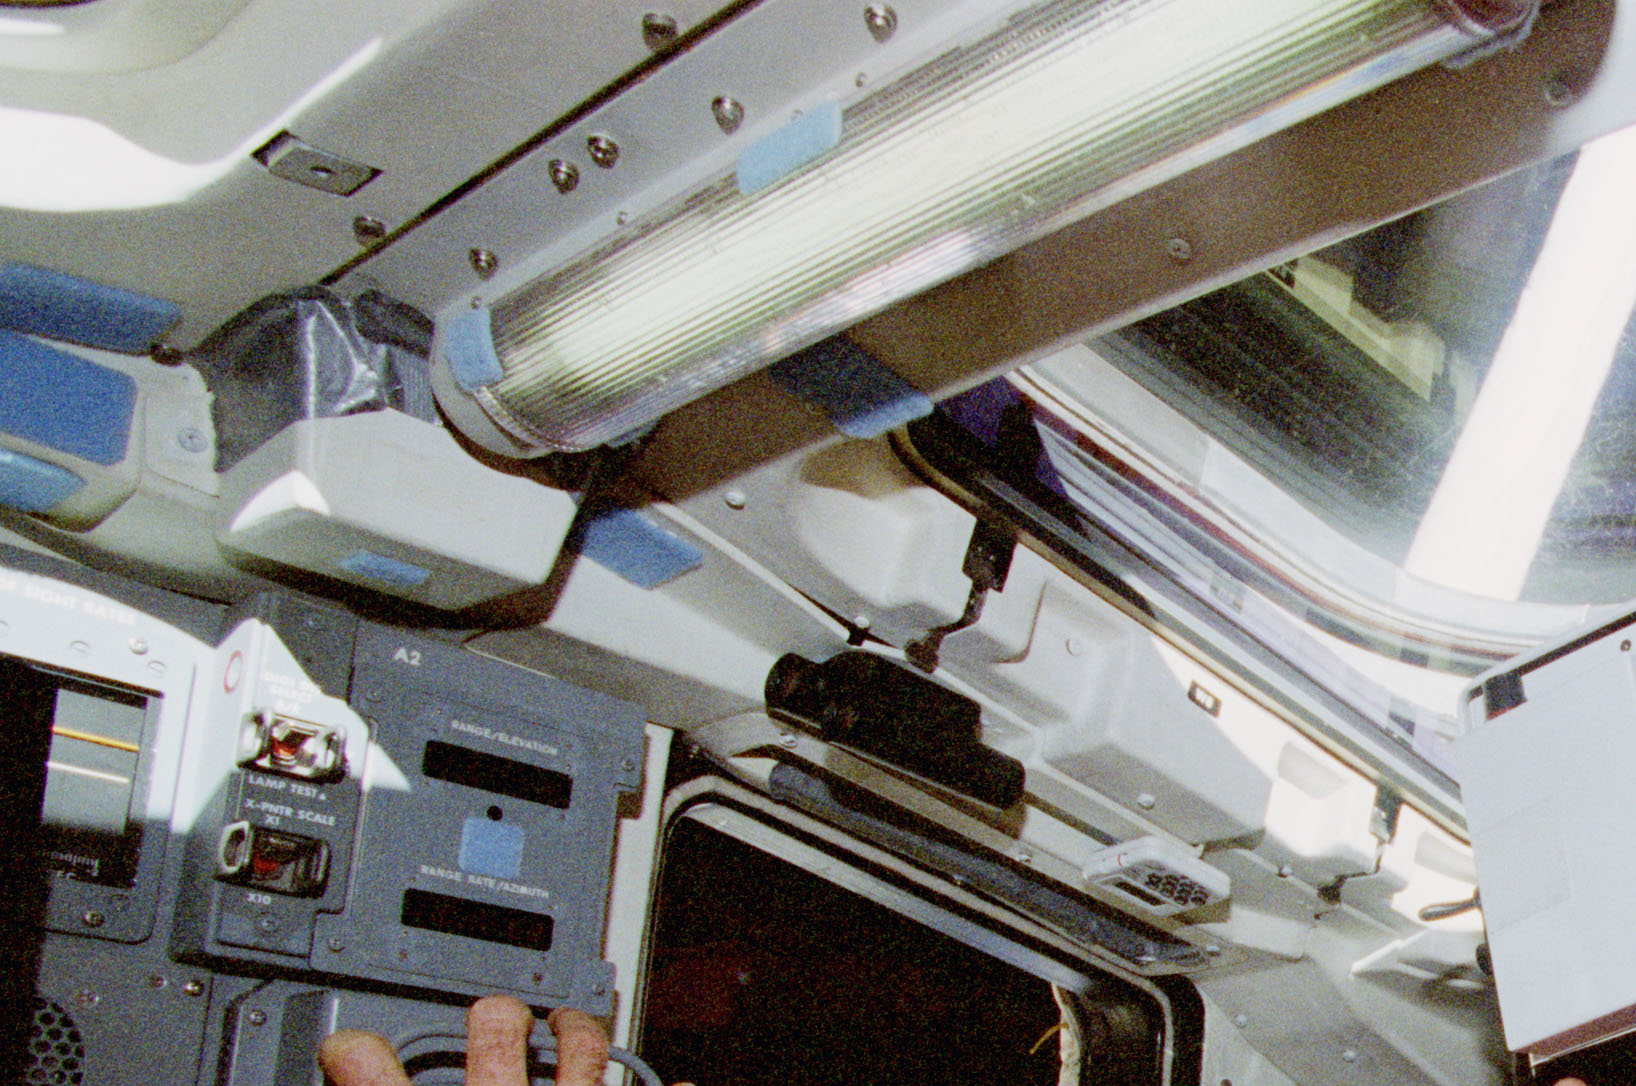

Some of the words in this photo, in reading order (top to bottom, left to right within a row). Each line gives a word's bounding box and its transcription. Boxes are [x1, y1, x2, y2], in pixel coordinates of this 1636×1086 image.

[82, 600, 136, 625] RATES
[392, 646, 422, 667] A2
[451, 719, 558, 755] RANGE/ELEVATION
[249, 774, 286, 790] LAMP
[290, 783, 318, 798] TEST
[244, 798, 294, 817] X-PNTR
[298, 810, 336, 826] SCALE
[420, 864, 462, 882] RANGE
[247, 892, 272, 905] X10
